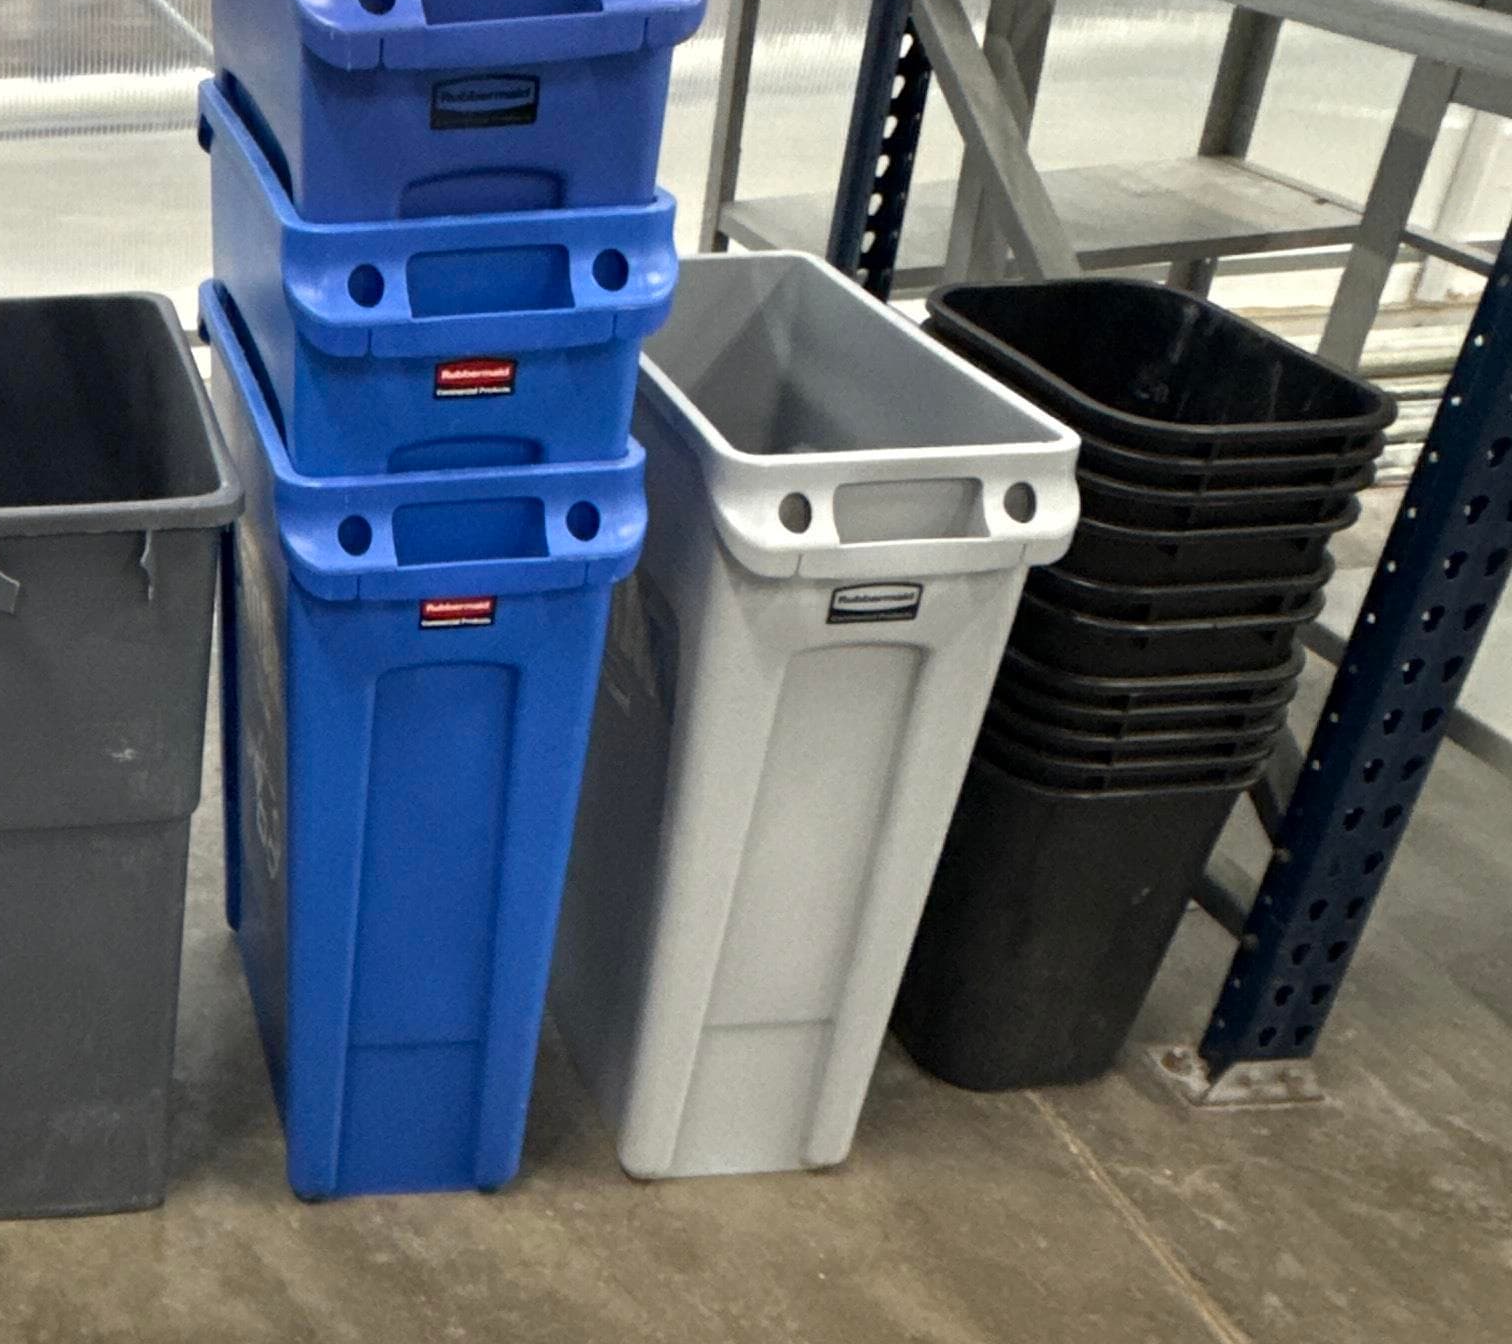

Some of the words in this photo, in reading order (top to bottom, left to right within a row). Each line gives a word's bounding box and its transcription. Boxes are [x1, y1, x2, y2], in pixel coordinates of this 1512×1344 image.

[441, 366, 511, 380] Rubbermaid
[837, 591, 915, 605] Rubbermaid
[425, 600, 491, 613] Rubbermaid
